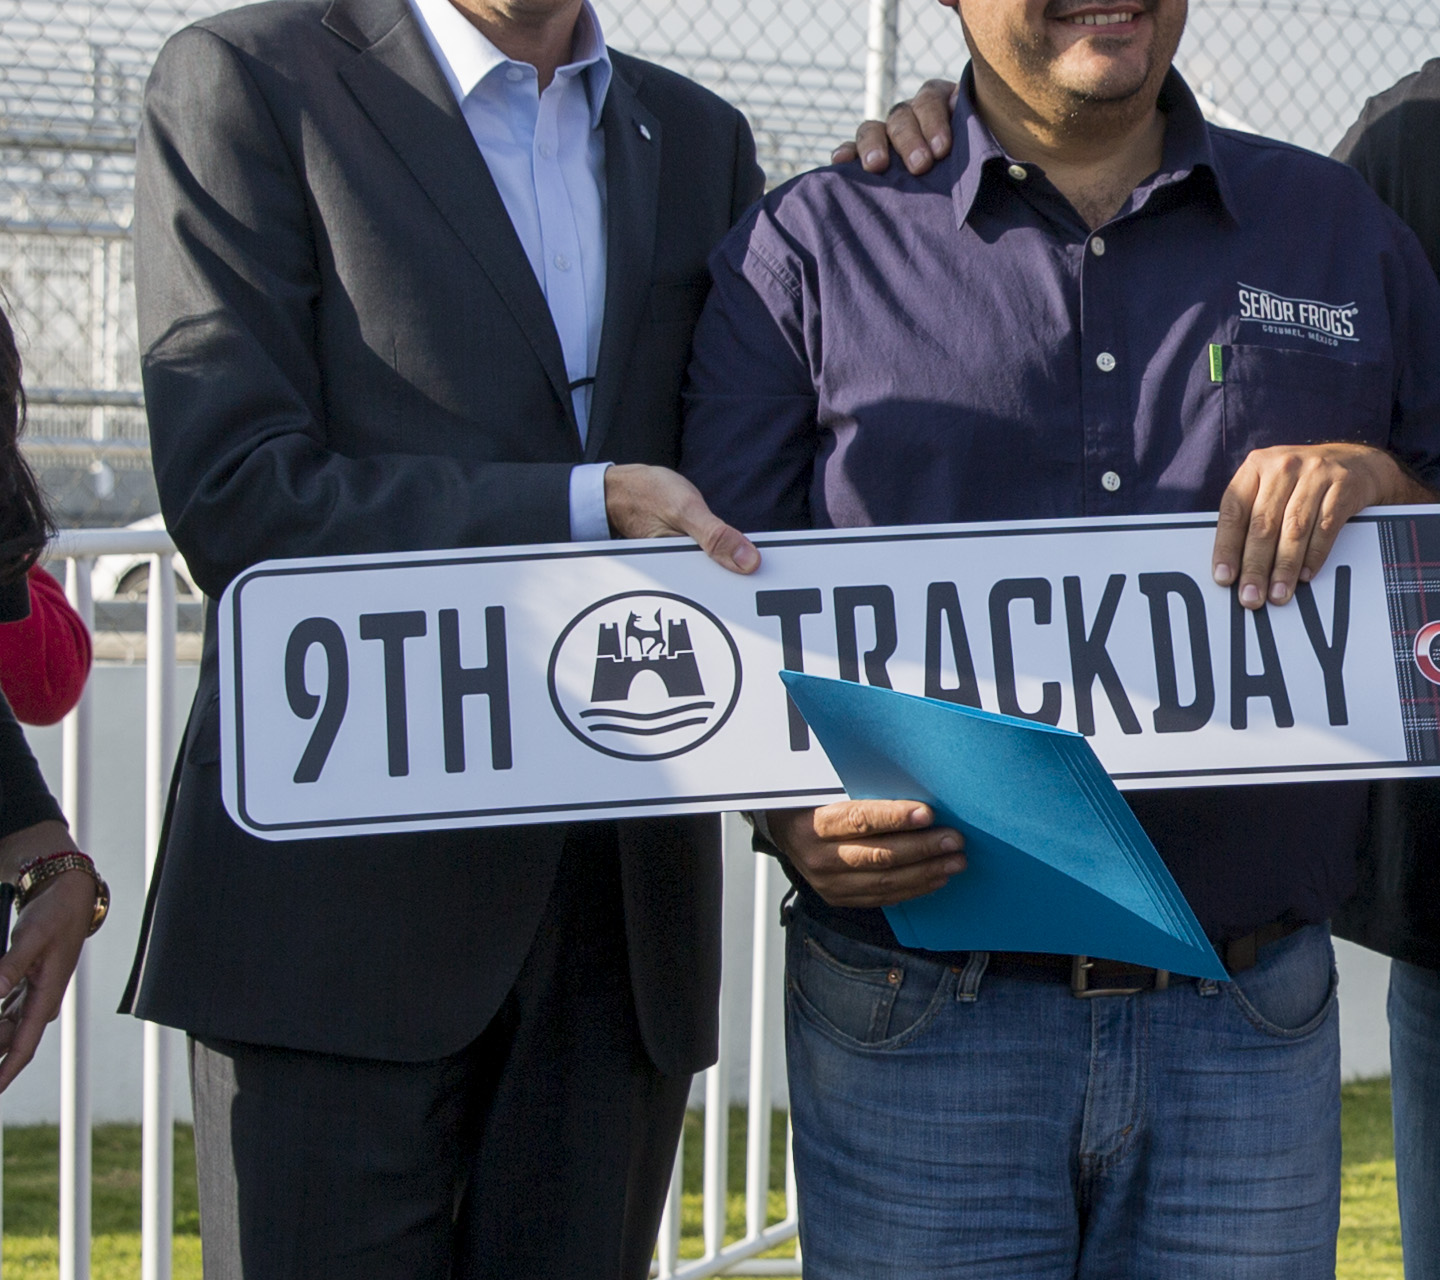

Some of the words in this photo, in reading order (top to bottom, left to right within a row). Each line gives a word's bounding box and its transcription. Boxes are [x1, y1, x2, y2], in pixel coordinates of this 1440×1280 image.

[1239, 289, 1295, 322] SEÑOR
[284, 605, 513, 783] 9TH
[756, 565, 1351, 751] TRACKDAY
